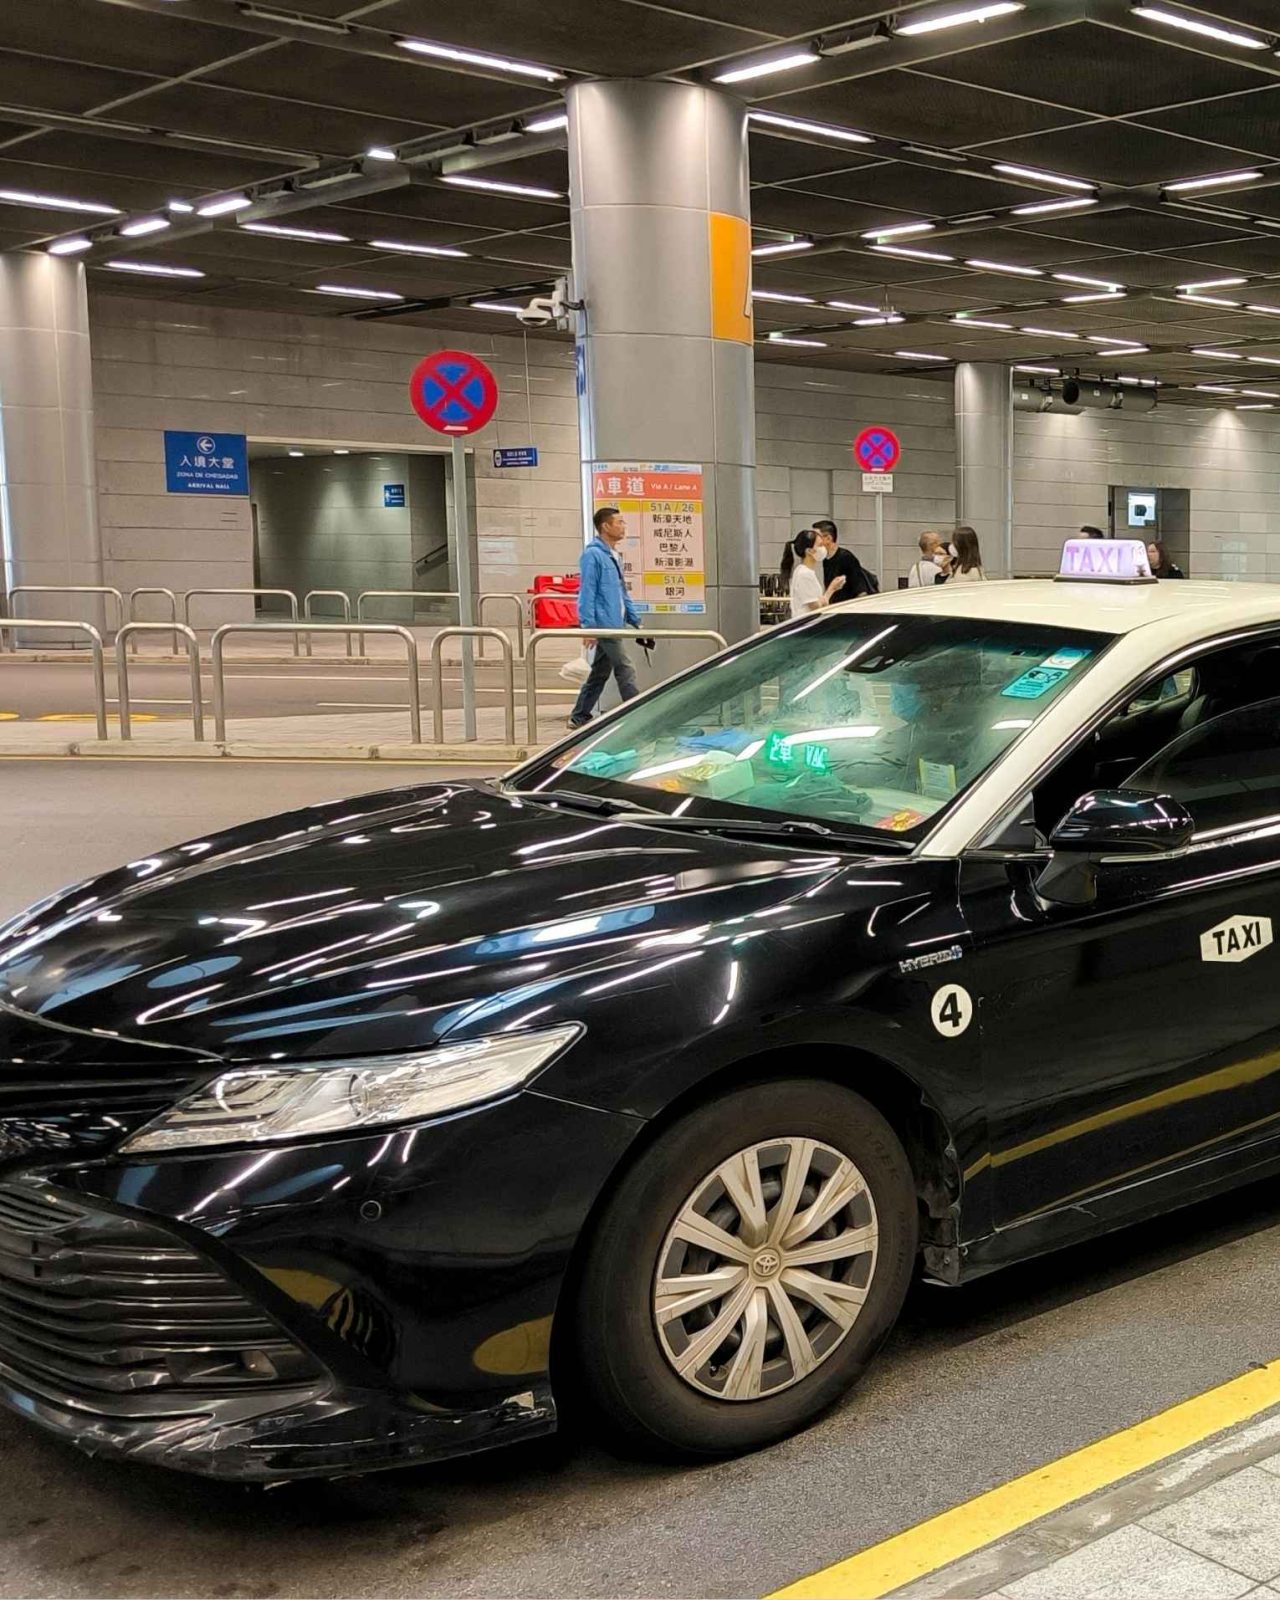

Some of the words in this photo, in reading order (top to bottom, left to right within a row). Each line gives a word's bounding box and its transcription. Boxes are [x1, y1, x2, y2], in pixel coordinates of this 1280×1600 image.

[180, 455, 234, 469] 入境大堂
[650, 503, 671, 512] 51A
[681, 504, 695, 513] 26
[653, 529, 693, 538] 威尼斯人
[1066, 545, 1124, 573] TAXI
[664, 575, 685, 584] 51A
[665, 587, 685, 596] 銀河
[1212, 921, 1262, 956] TAXI
[898, 949, 953, 974] HYBRID
[939, 991, 962, 1028] 4
